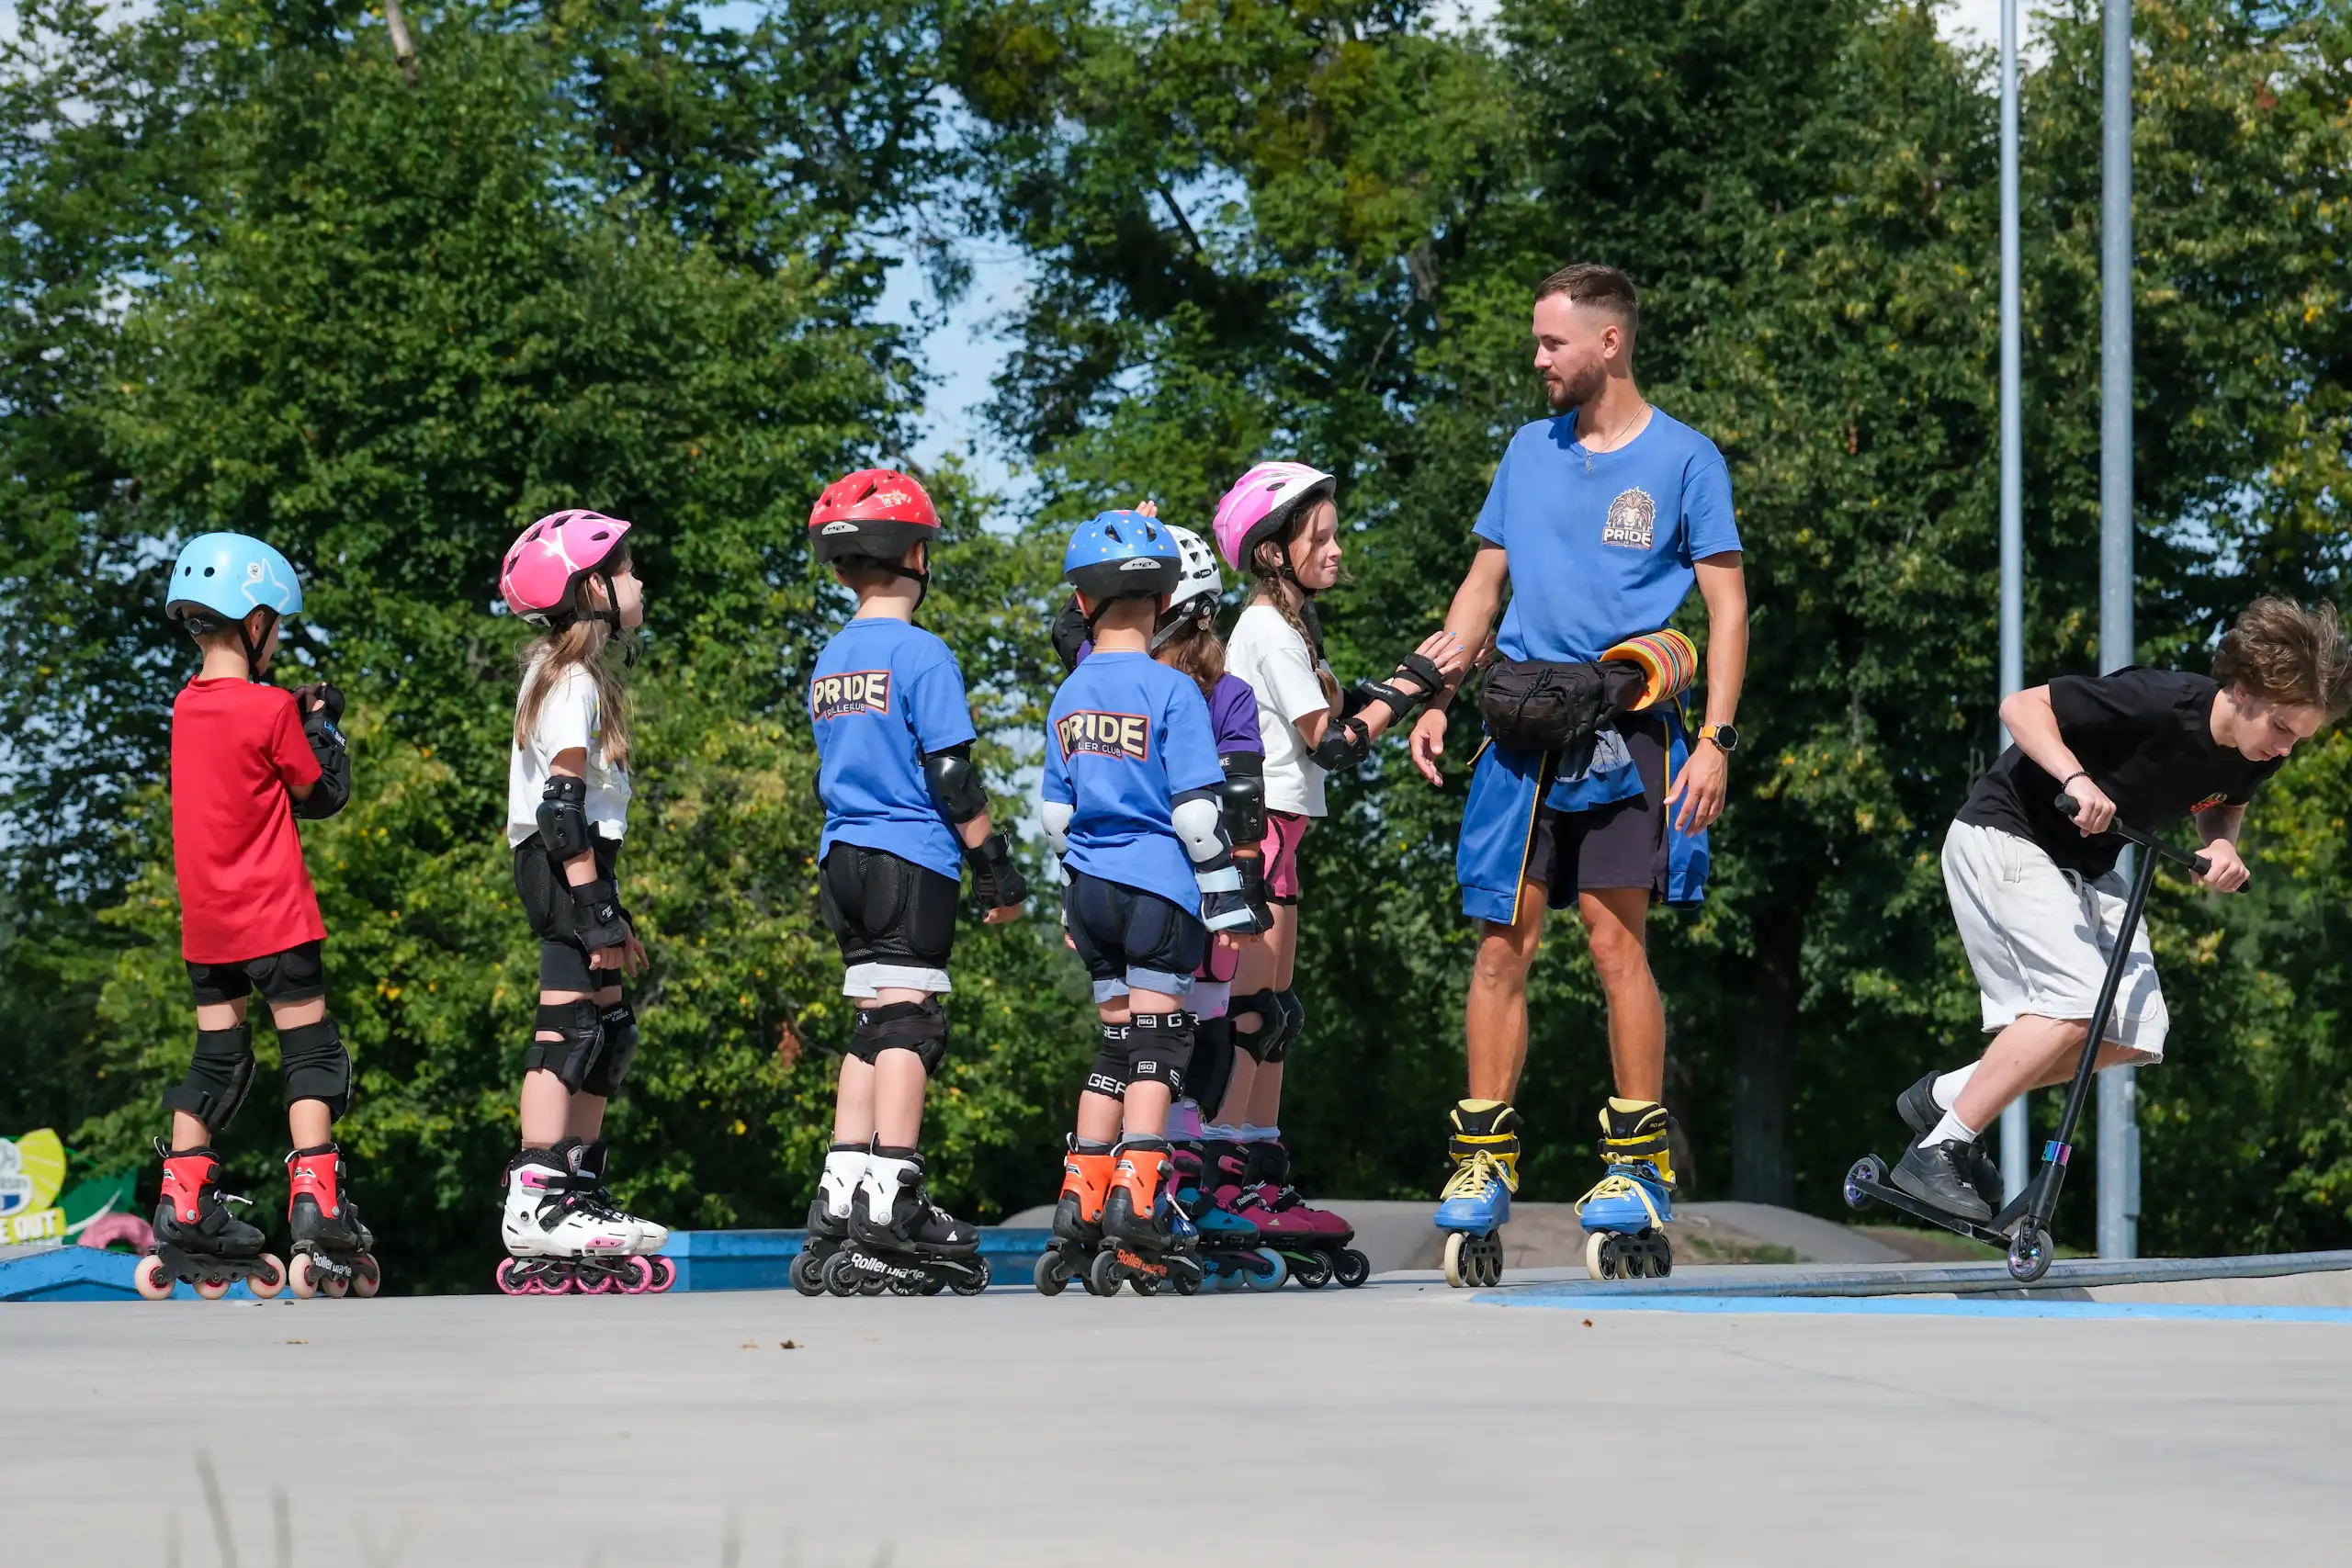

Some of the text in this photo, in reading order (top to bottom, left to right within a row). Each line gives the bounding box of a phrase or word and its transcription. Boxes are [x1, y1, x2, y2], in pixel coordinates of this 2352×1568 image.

[1603, 528, 1652, 548] PRIDE
[814, 674, 888, 715] PRIDE
[1058, 715, 1146, 756] PRIDE
[1102, 744, 1122, 757] CLUB
[851, 1252, 925, 1281] Rollerblade
